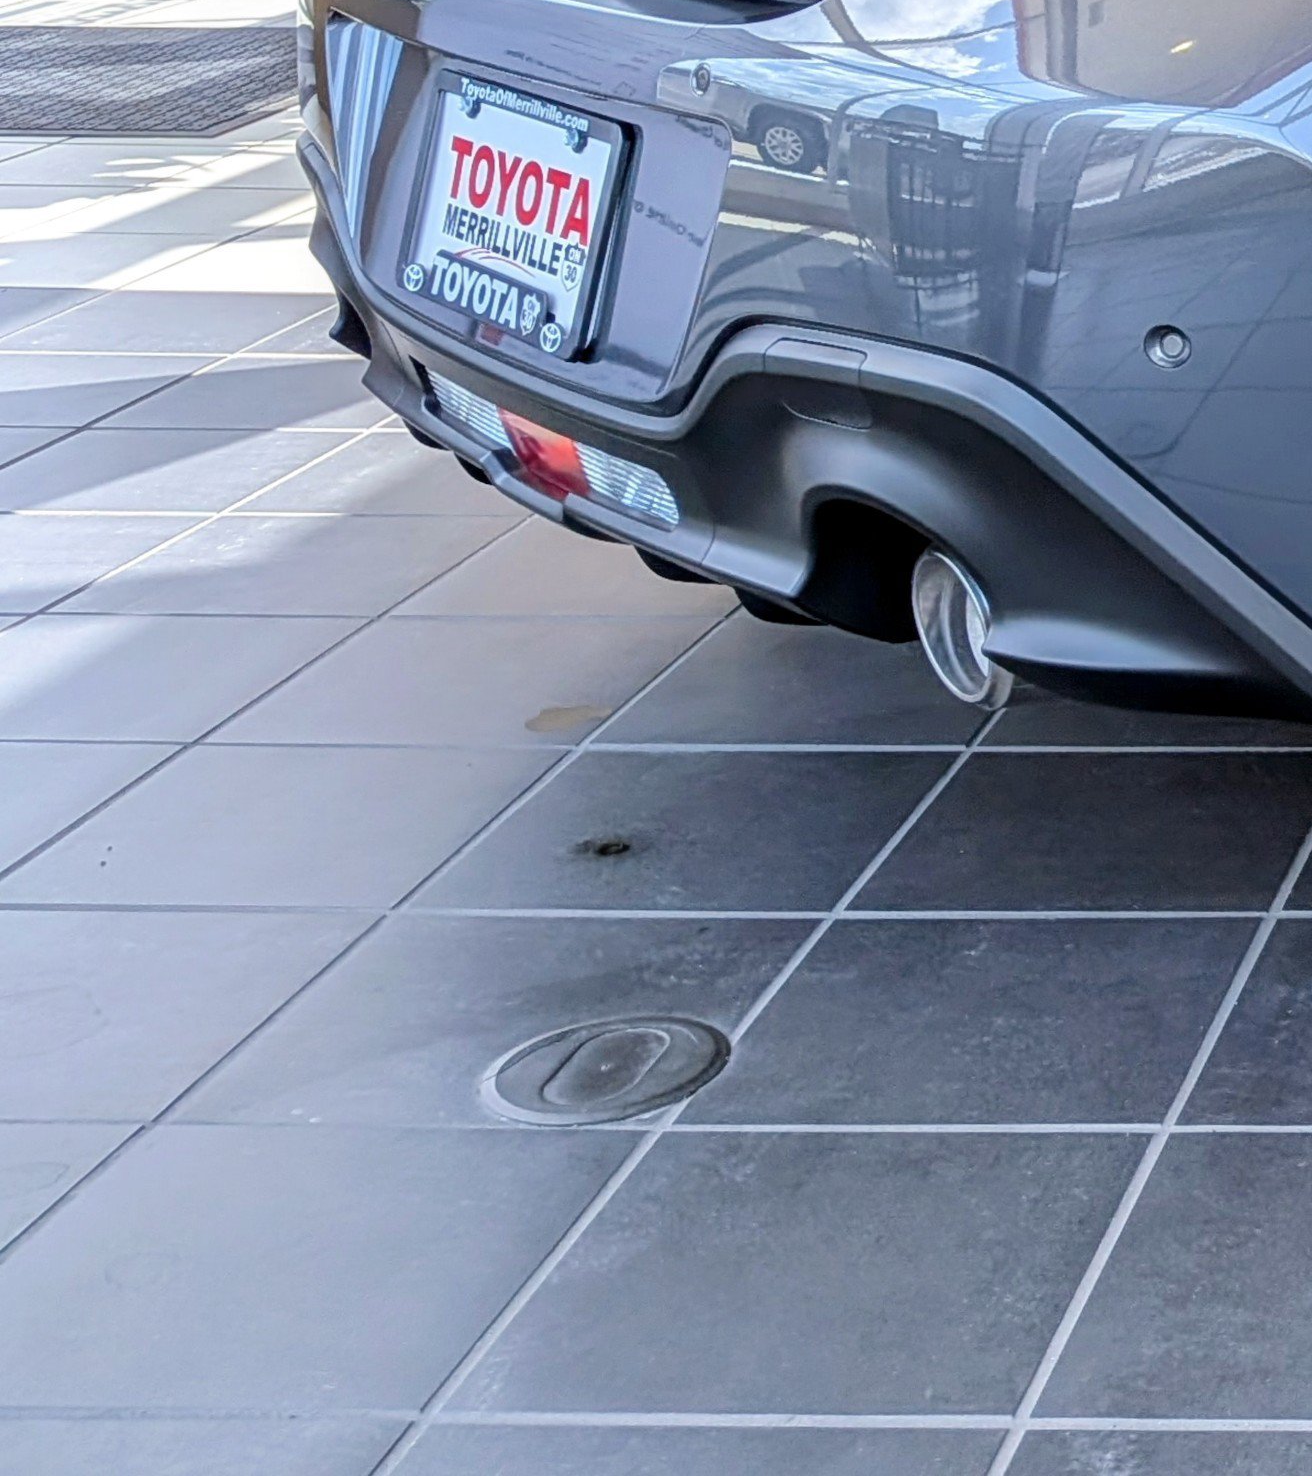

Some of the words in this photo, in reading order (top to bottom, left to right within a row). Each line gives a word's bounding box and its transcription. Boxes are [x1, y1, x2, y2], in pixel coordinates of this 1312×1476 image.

[461, 78, 589, 132] ToyotaOfMerrillville.com
[450, 135, 590, 247] TOYOTA
[442, 203, 563, 276] MERRILLVILLE
[568, 249, 582, 262] ON
[431, 255, 519, 330] TOYOTA
[564, 264, 578, 284] 30
[523, 311, 534, 325] 30
